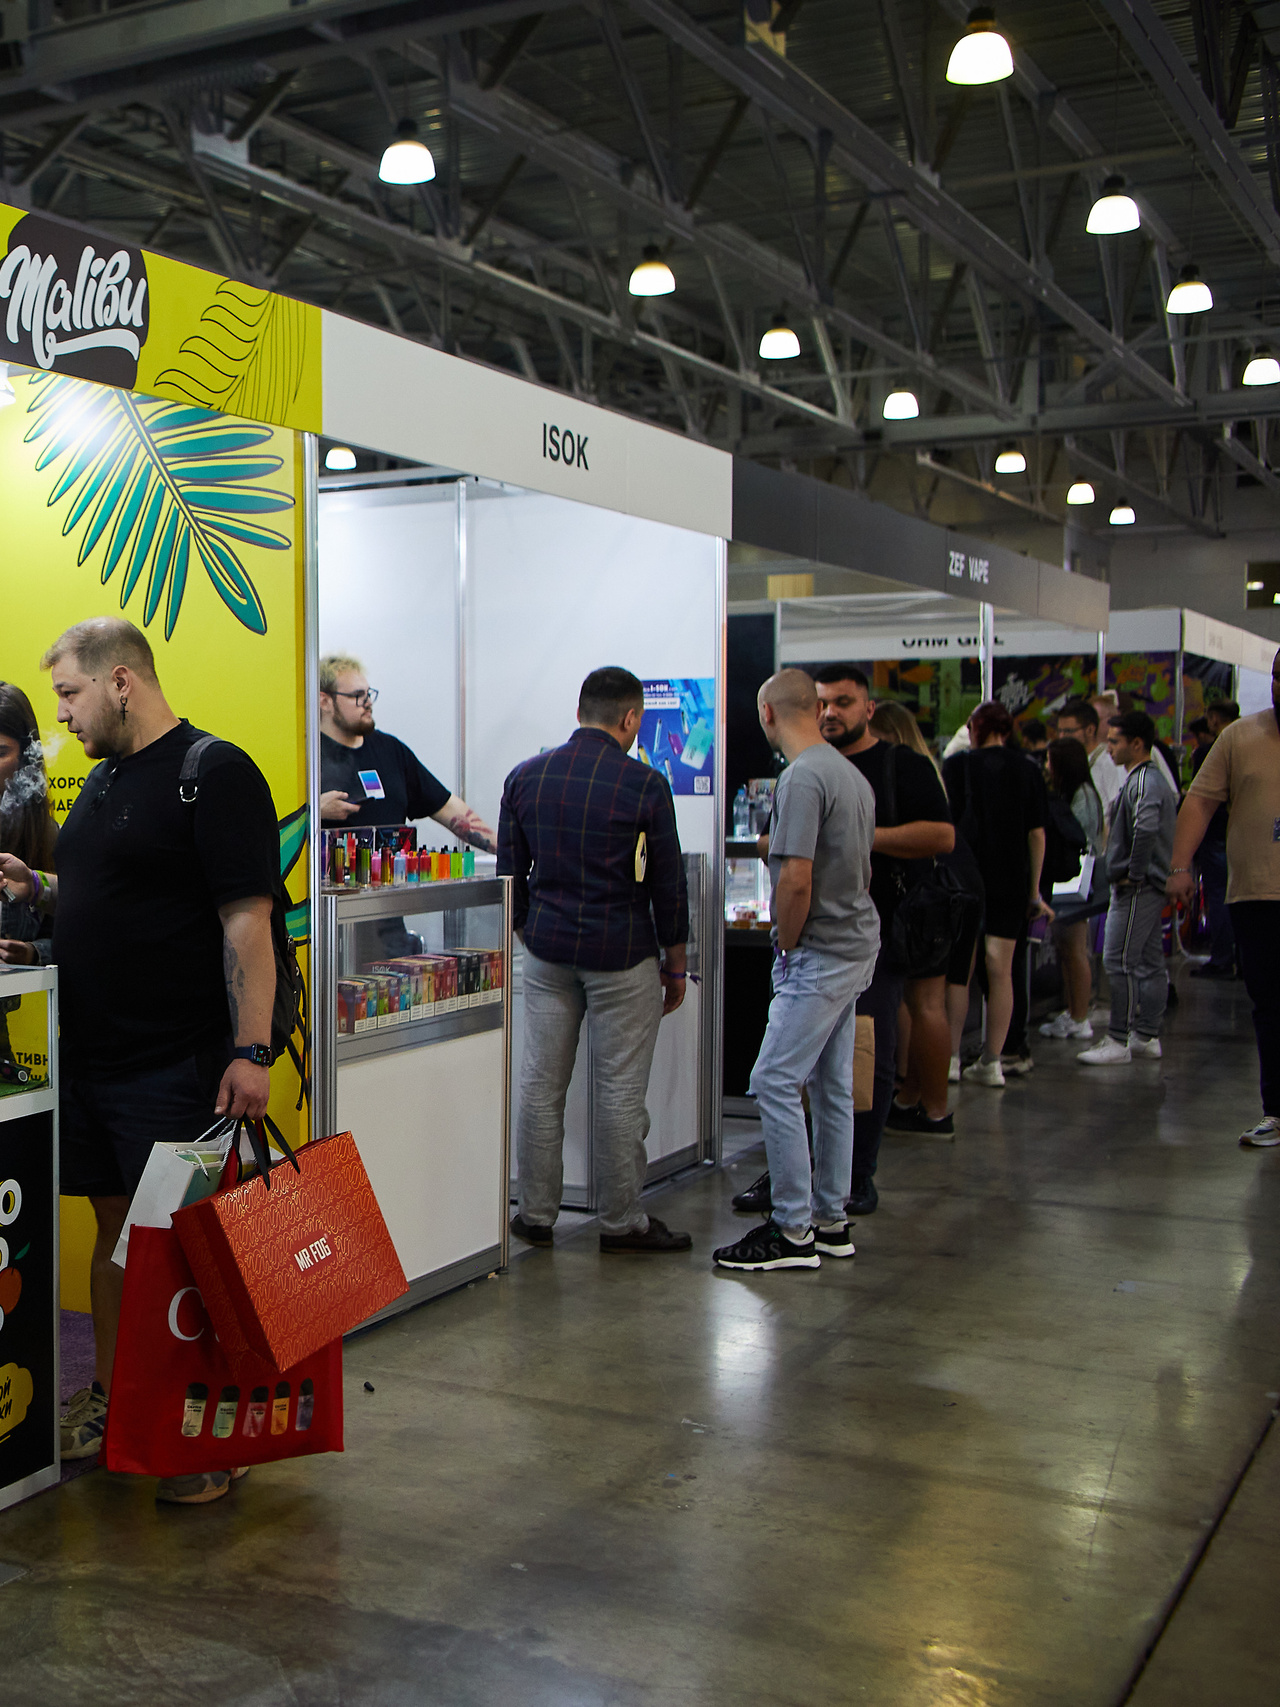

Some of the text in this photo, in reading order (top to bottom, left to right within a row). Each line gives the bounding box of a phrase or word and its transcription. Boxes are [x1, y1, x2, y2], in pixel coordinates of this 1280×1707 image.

[543, 422, 589, 471] ISOK
[949, 550, 989, 584] ZEF VAPE
[294, 1237, 332, 1272] MR FOG
